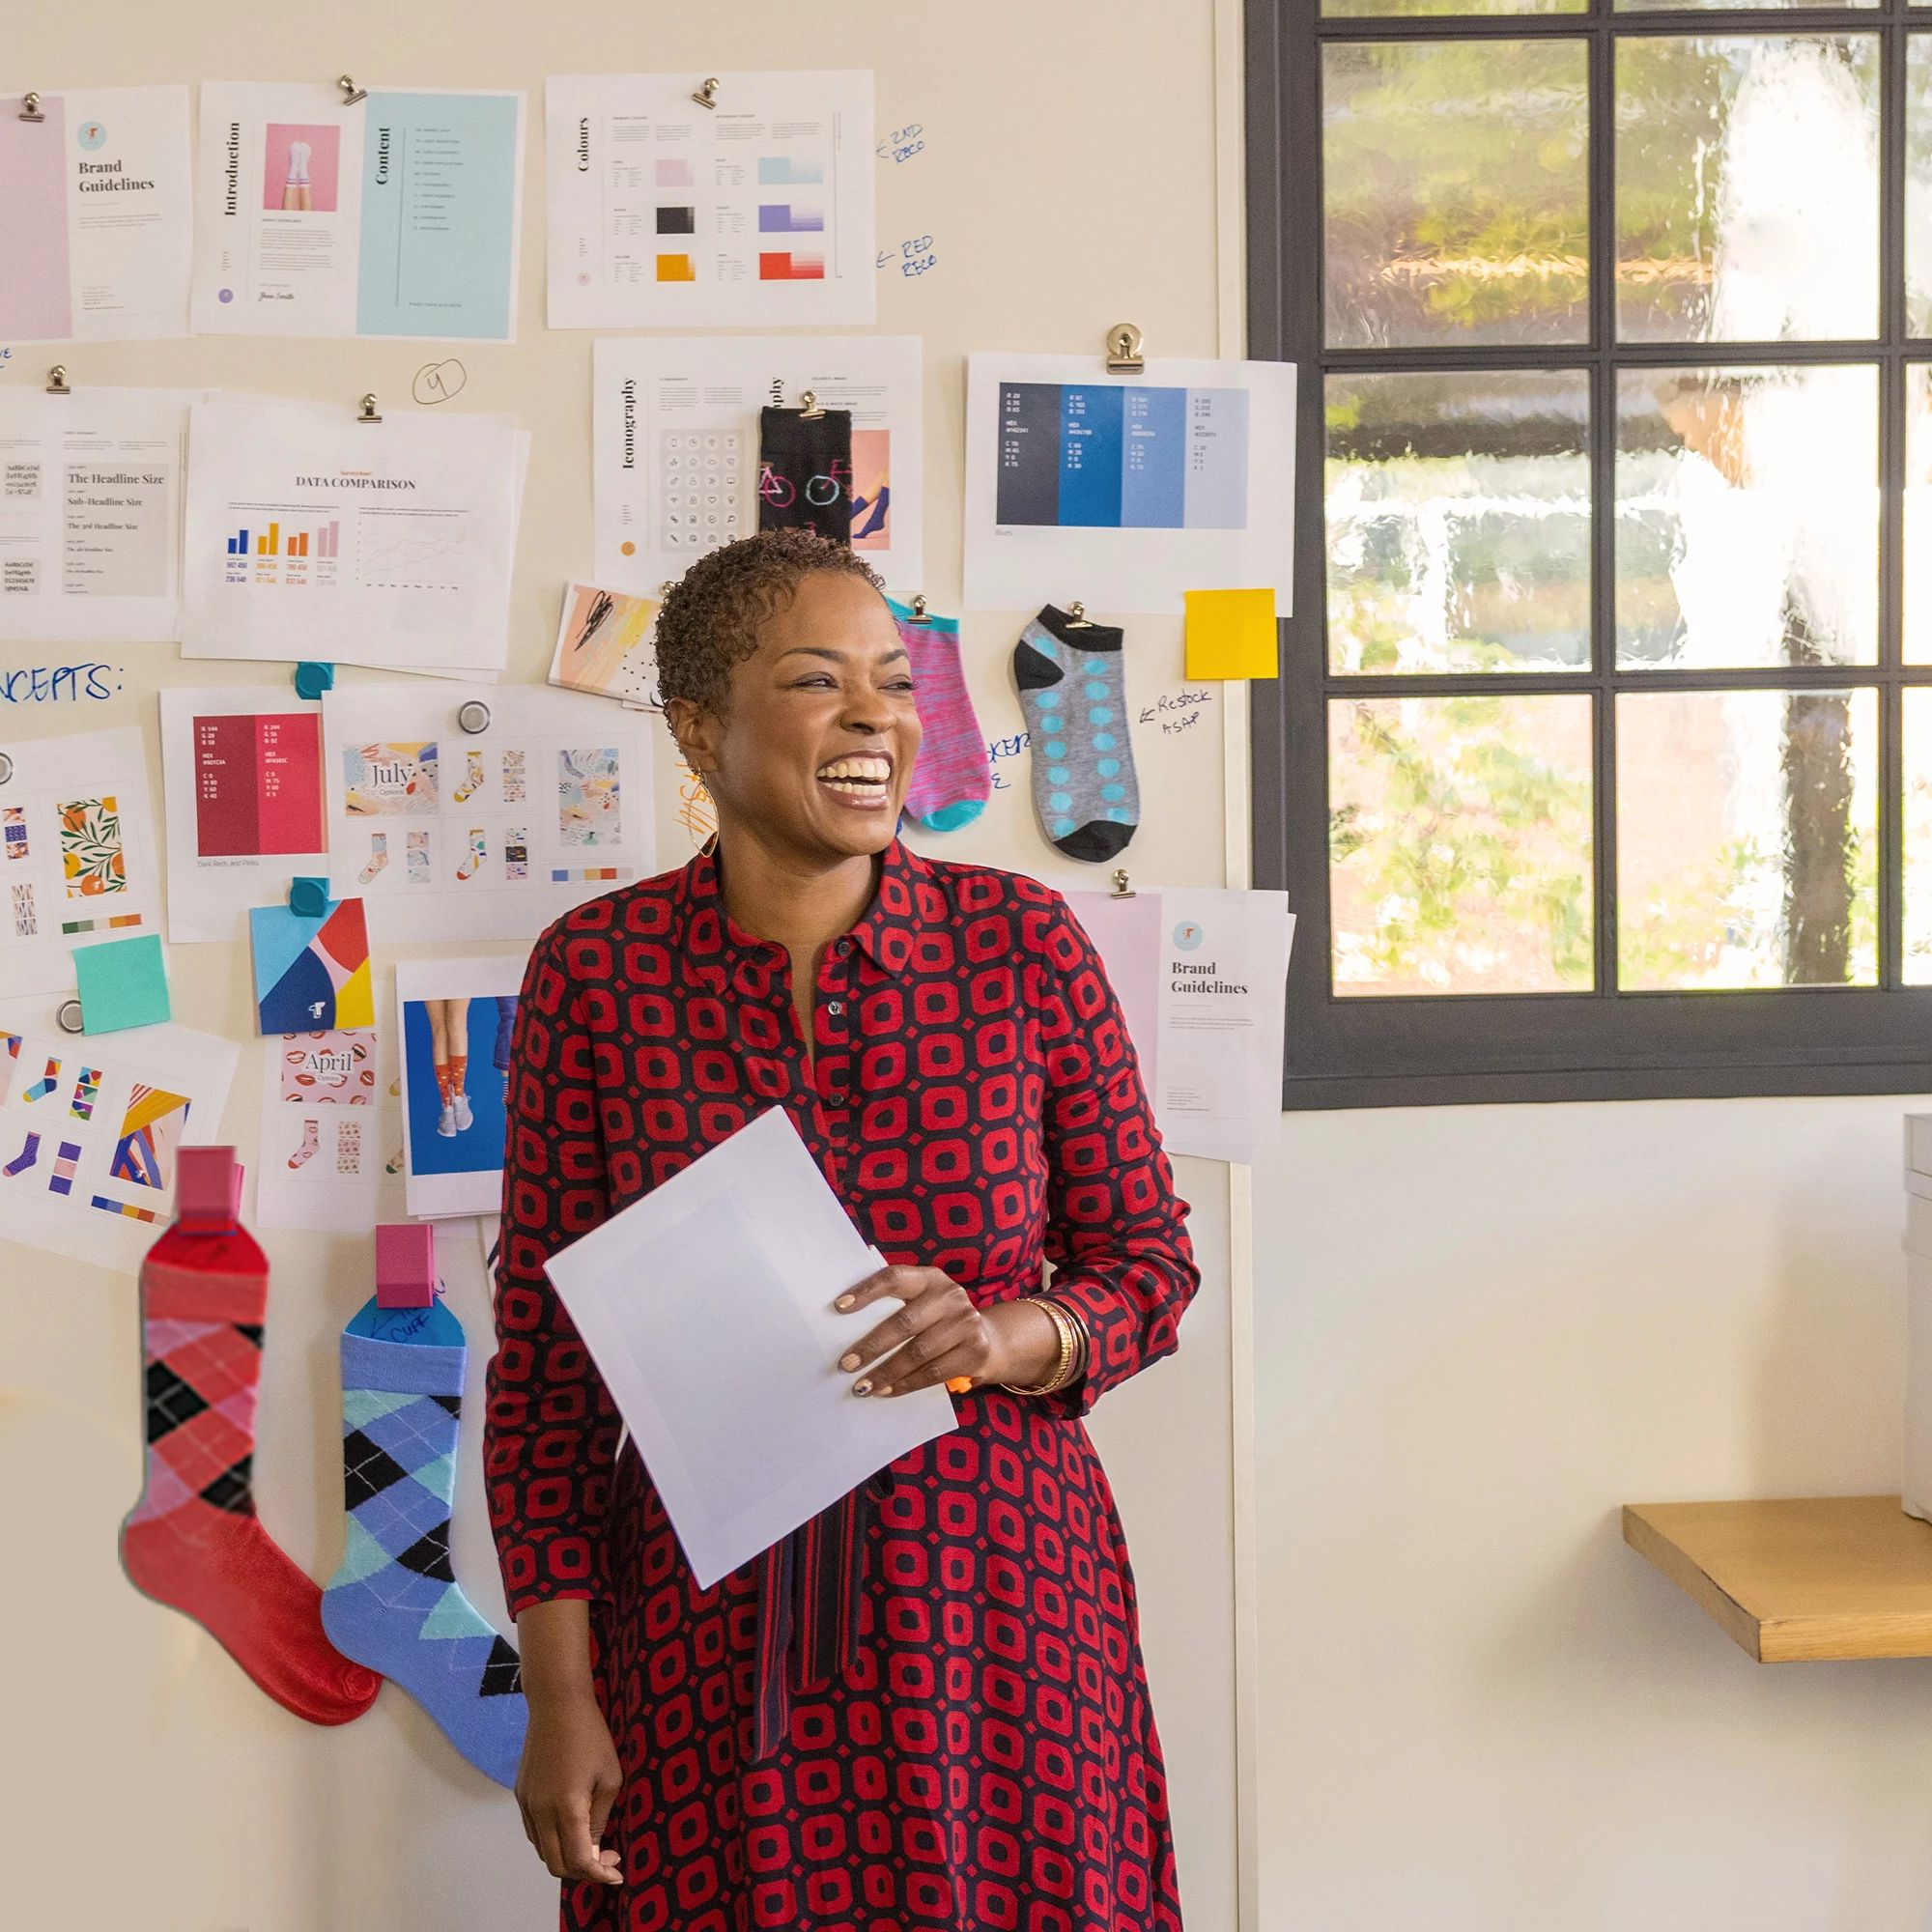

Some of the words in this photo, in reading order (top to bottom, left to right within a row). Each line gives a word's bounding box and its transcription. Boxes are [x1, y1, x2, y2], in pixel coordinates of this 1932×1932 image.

[578, 117, 589, 171] Colours
[78, 159, 123, 174] Brand
[376, 128, 390, 185] Content
[225, 122, 240, 216] Introduction
[79, 177, 155, 193] Guidelines
[901, 235, 934, 258] RED
[621, 377, 637, 469] Iconography
[68, 474, 89, 484] The
[92, 474, 140, 484] Headline
[142, 474, 164, 485] Size
[296, 476, 329, 487] DATA
[332, 477, 416, 490] COMPARISON
[68, 497, 124, 507] Sub-Headline
[126, 498, 143, 507] Size
[1162, 711, 1200, 735] ASAP
[372, 763, 411, 788] July
[1172, 962, 1216, 975] Brand
[1171, 980, 1248, 994] Guidelines
[305, 1053, 352, 1073] April
